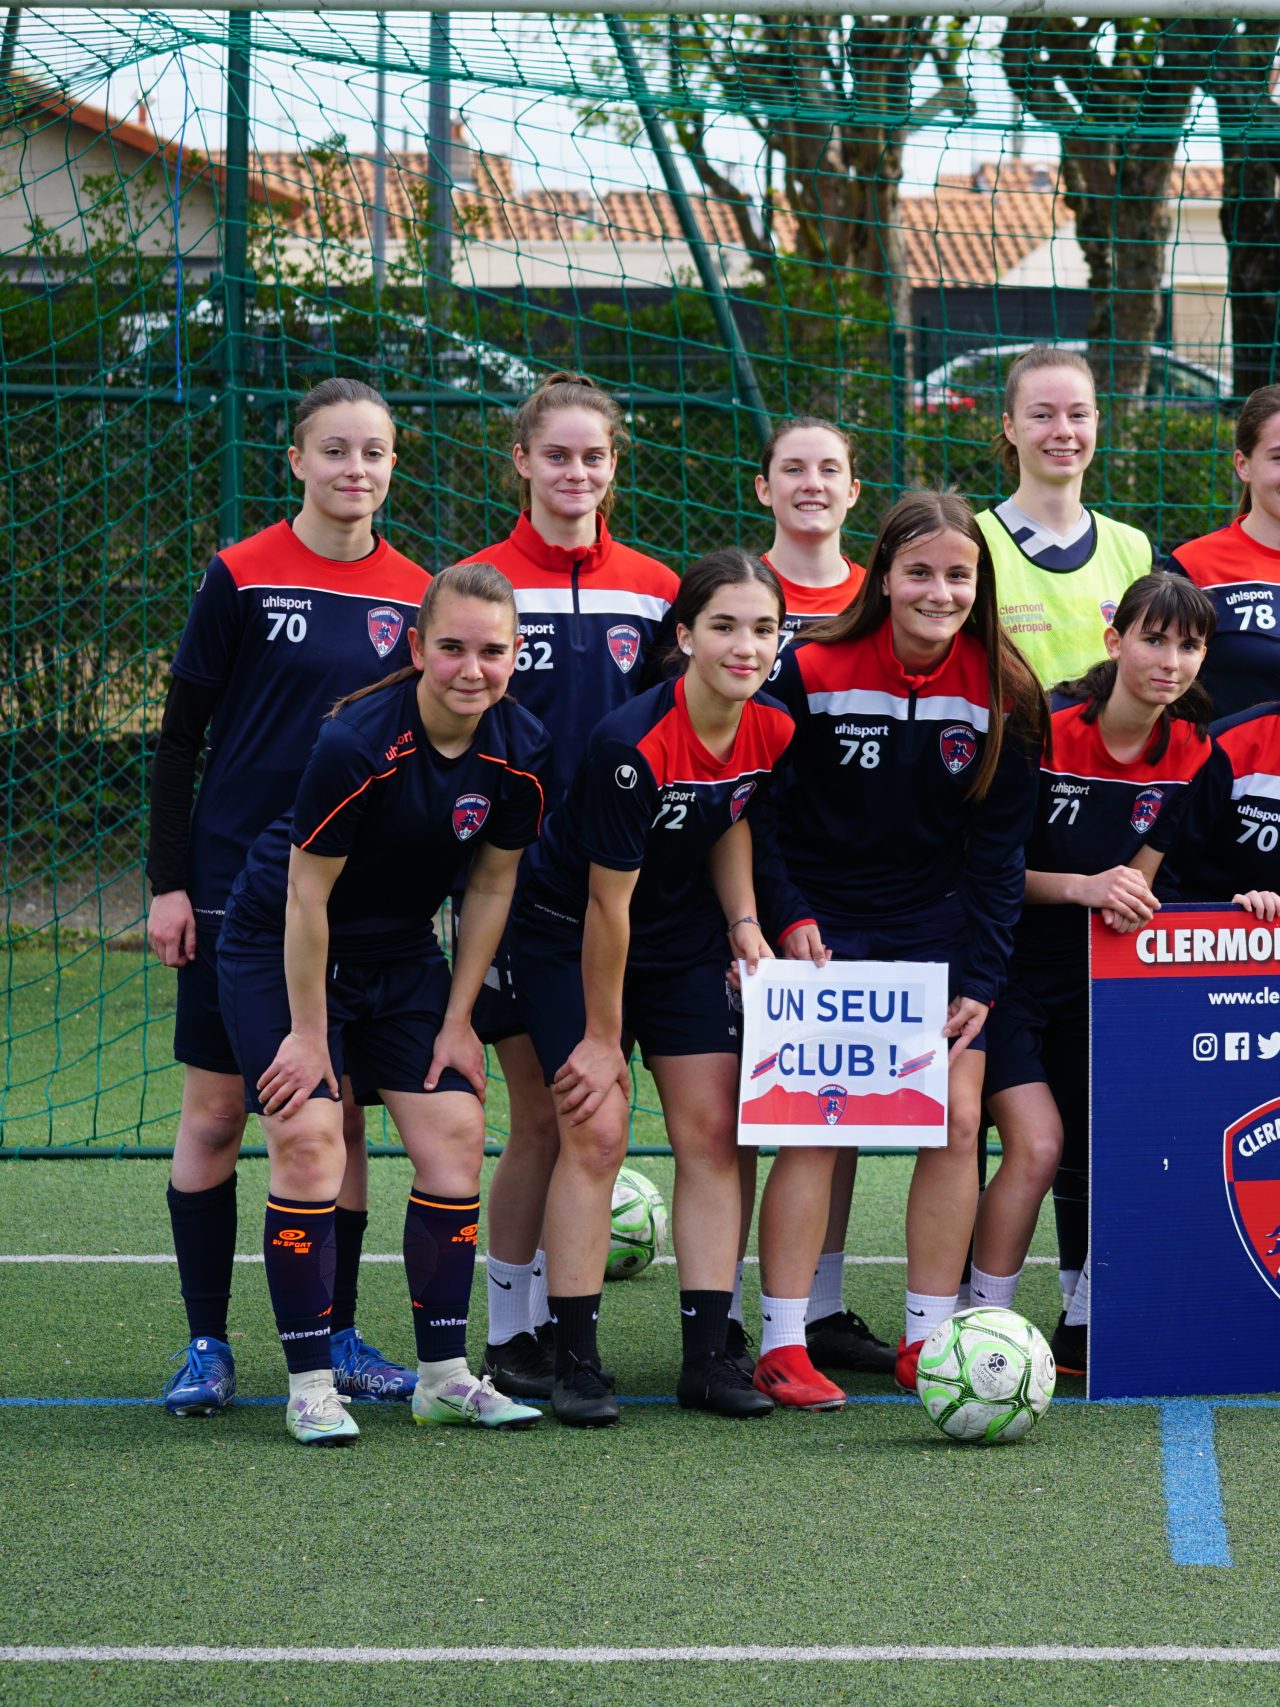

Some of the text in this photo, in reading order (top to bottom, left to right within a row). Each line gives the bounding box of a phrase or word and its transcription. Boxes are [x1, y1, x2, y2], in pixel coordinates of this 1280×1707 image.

[262, 595, 312, 610] uhlsport
[1226, 590, 1274, 605] uhlsport
[266, 612, 307, 643] 70
[1234, 604, 1276, 630] 78
[515, 641, 554, 671] 62
[835, 722, 889, 738] uhlsport
[839, 739, 881, 769] 78
[1051, 782, 1090, 796] uhlsport
[1048, 798, 1080, 825] 71
[1236, 818, 1279, 852] 70
[767, 988, 804, 1021] UN
[817, 989, 923, 1023] SEUL
[778, 1042, 875, 1077] CLUB
